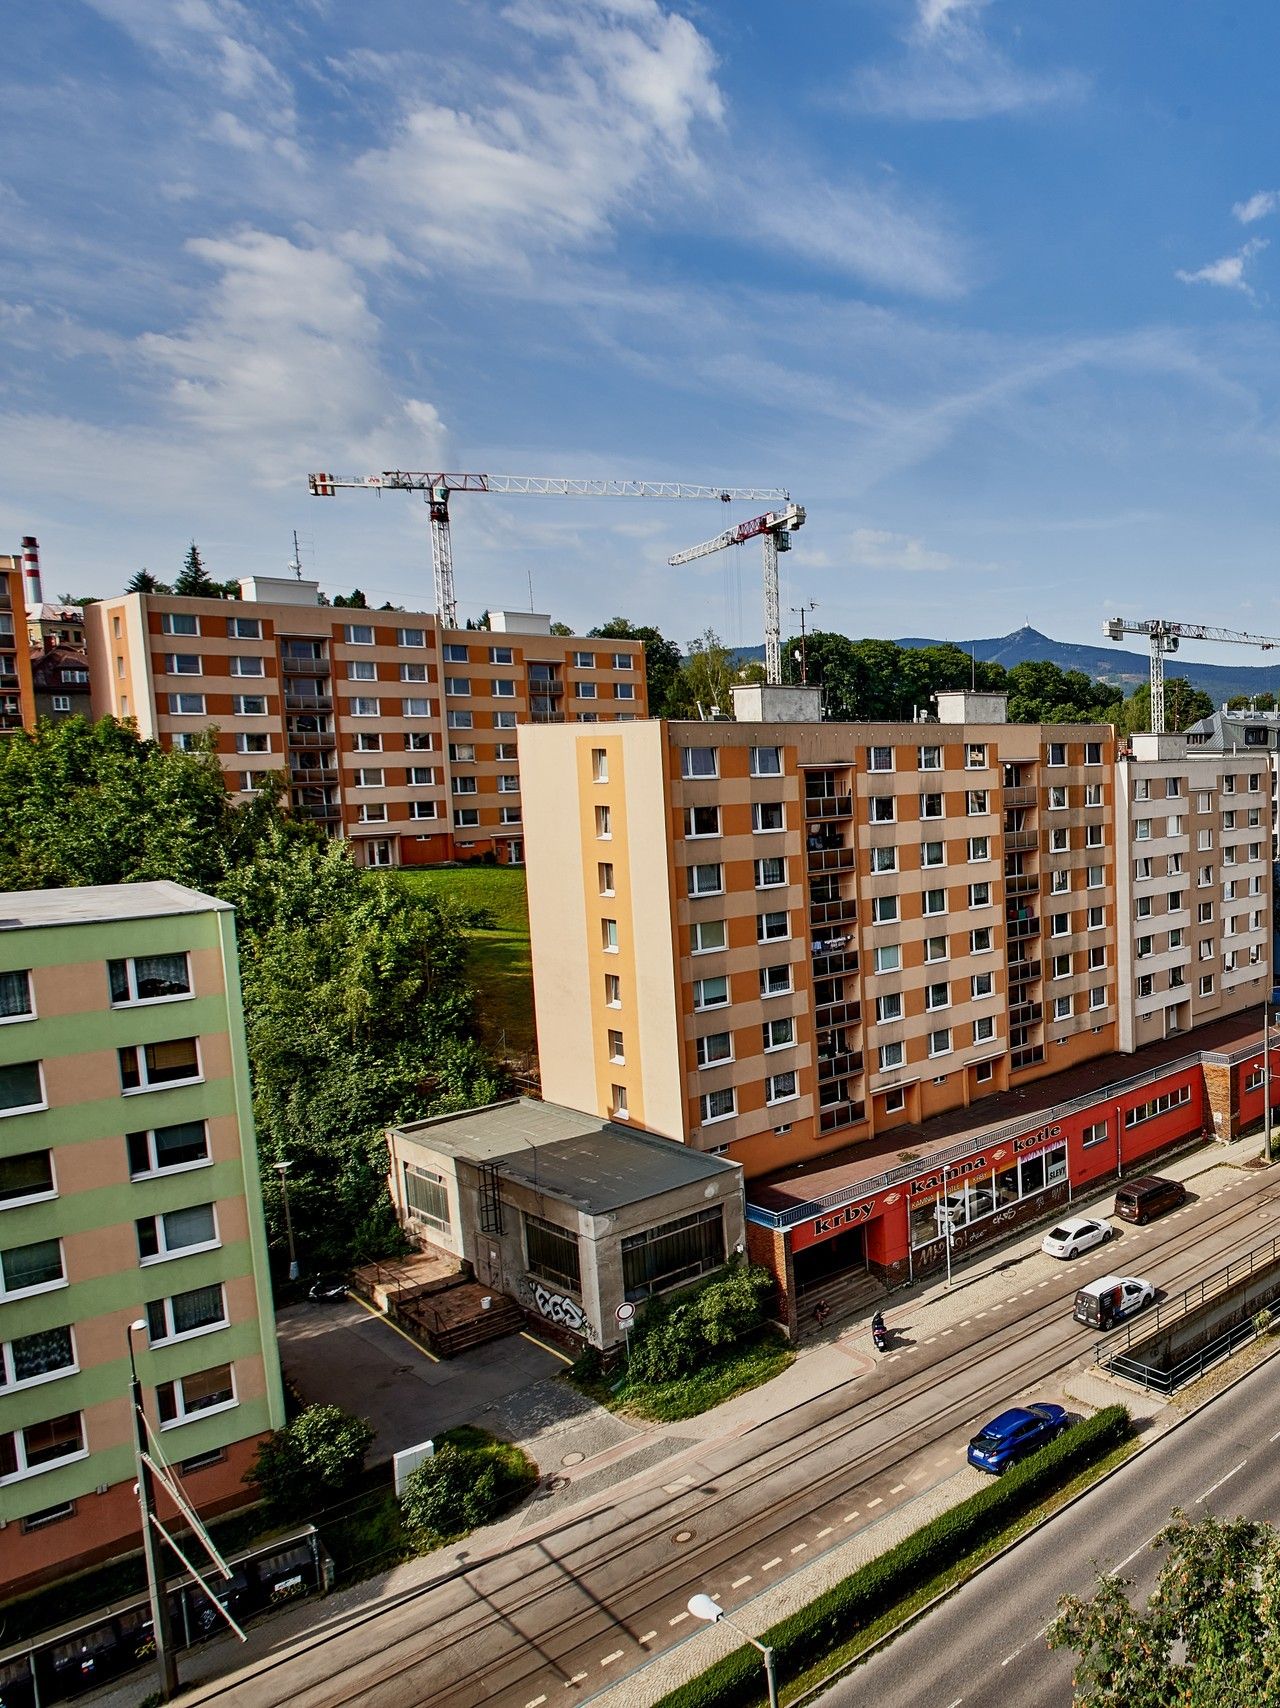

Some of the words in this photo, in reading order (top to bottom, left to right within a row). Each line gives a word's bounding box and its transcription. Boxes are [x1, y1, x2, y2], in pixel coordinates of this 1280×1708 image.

[814, 1200, 876, 1237] krby
[910, 1156, 987, 1197] kamna
[1012, 1125, 1061, 1154] kotle
